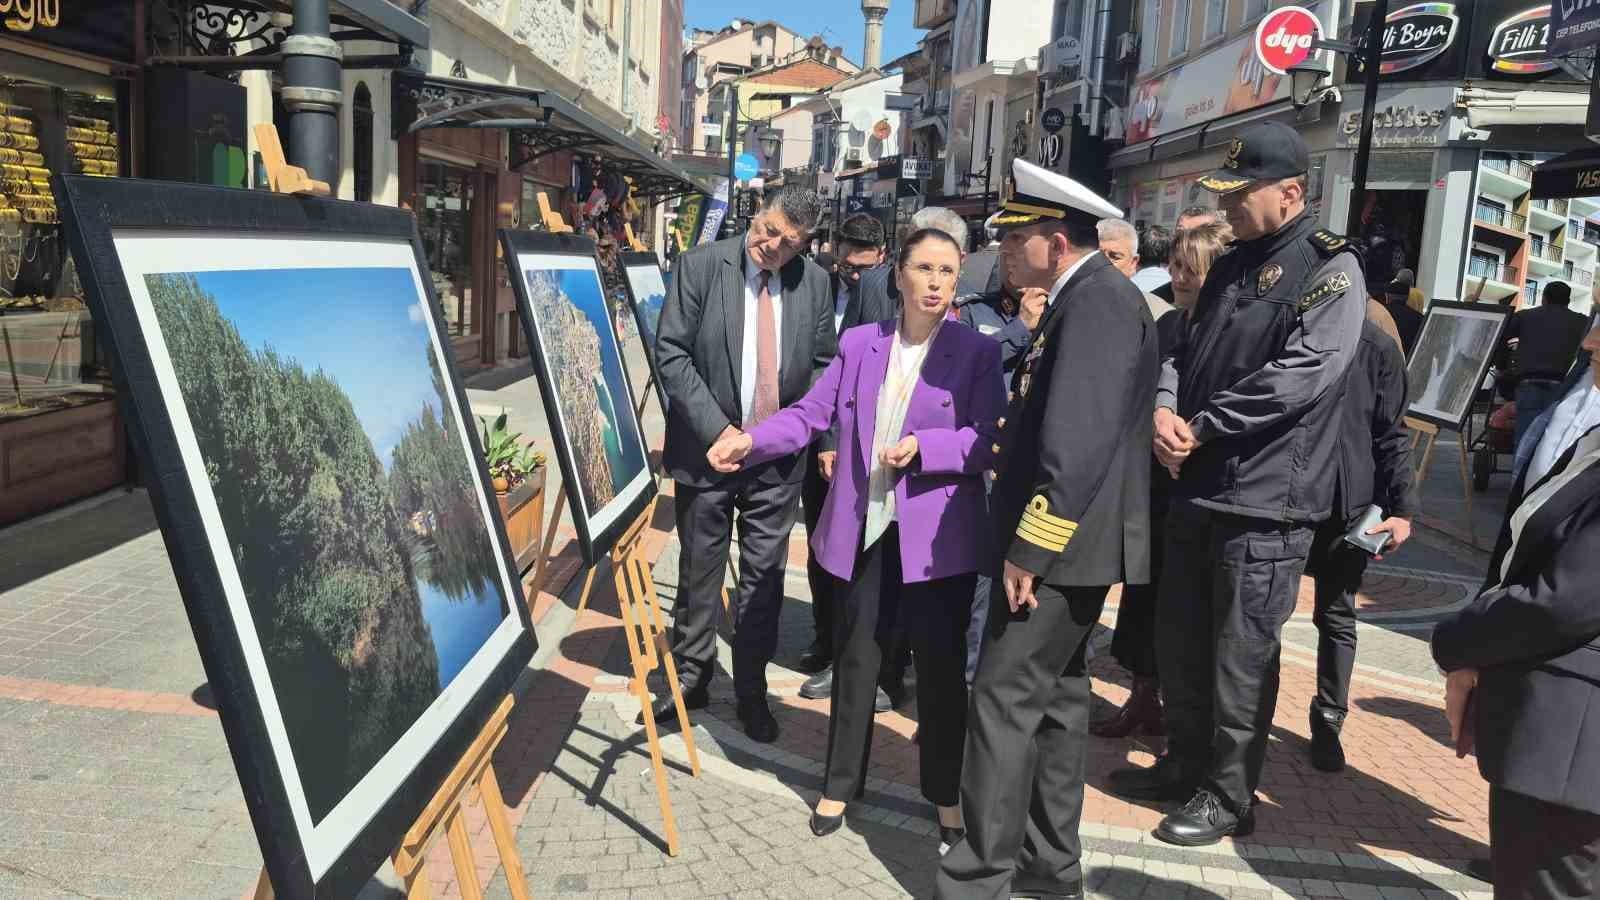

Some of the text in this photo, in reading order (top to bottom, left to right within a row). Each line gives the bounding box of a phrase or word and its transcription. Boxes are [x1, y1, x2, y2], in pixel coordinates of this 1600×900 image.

[1266, 26, 1313, 54] dya
[1400, 23, 1448, 48] Boya
[1502, 25, 1538, 52] Filli
